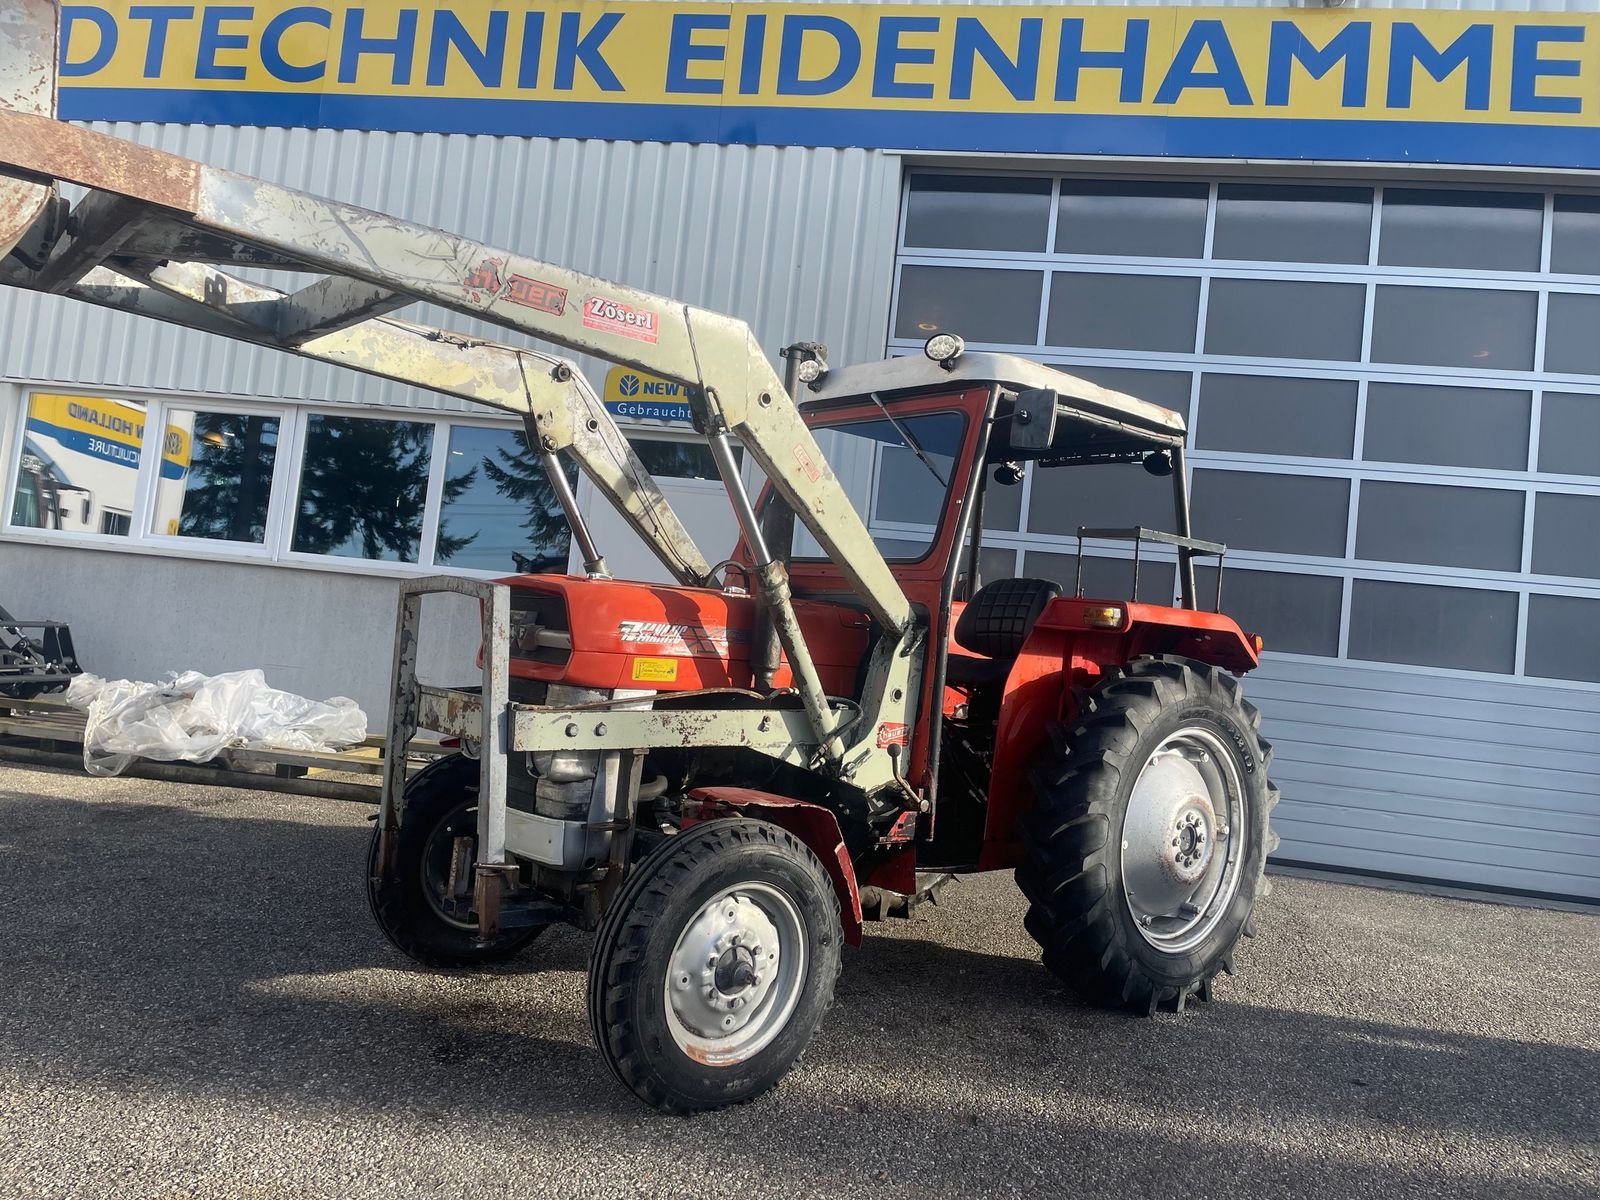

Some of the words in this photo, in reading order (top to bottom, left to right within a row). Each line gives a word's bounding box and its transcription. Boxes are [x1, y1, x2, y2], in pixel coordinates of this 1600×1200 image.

[665, 15, 1586, 114] EIDENHAMME
[591, 297, 653, 329] Zöserl
[643, 381, 680, 397] NEW
